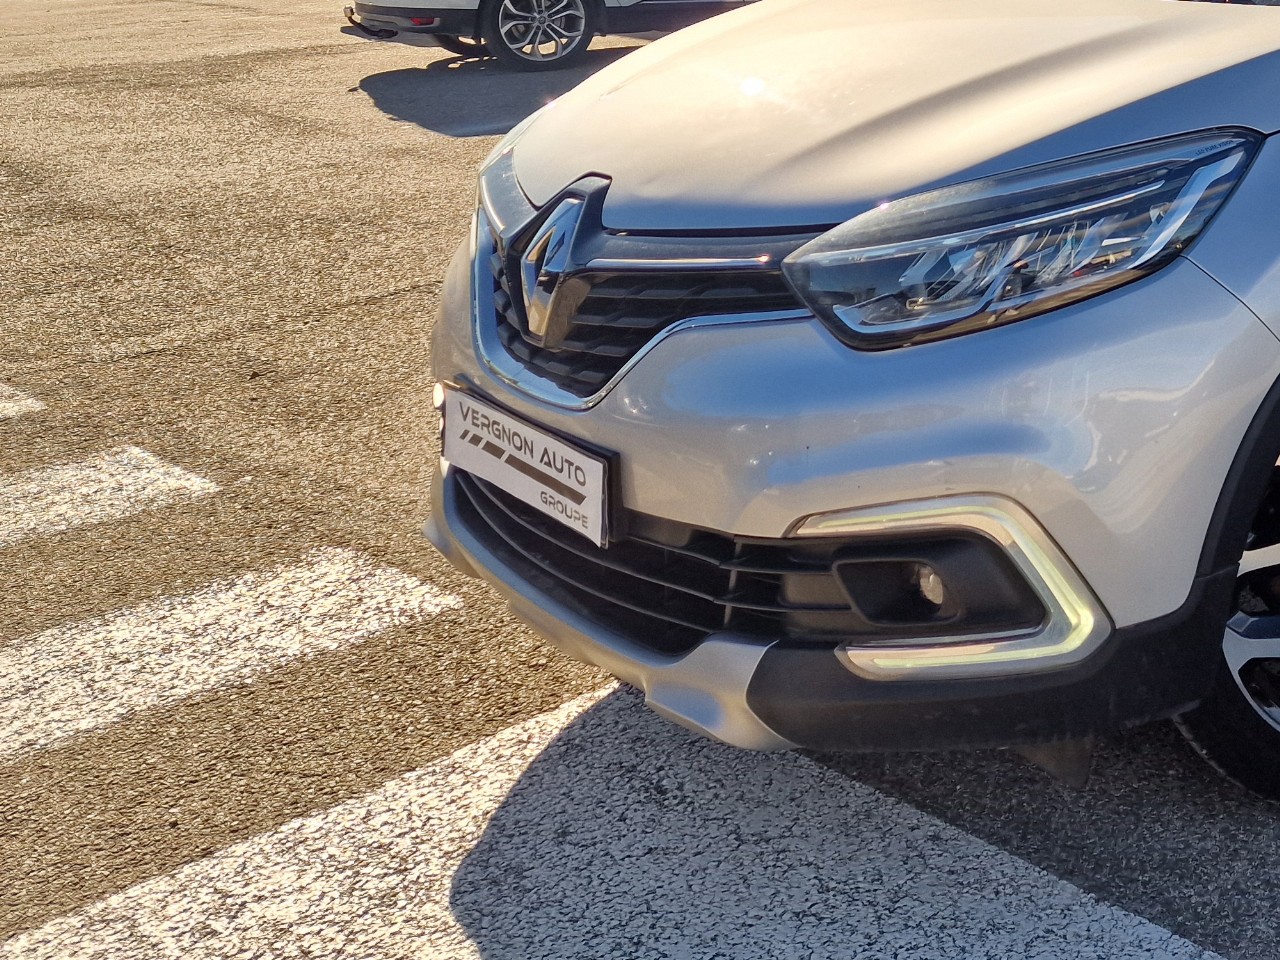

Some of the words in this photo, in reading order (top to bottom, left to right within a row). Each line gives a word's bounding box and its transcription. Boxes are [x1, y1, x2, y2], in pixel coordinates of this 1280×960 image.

[459, 401, 534, 459] VERGNON
[539, 447, 587, 487] AUTO
[539, 491, 589, 530] GROUPE
